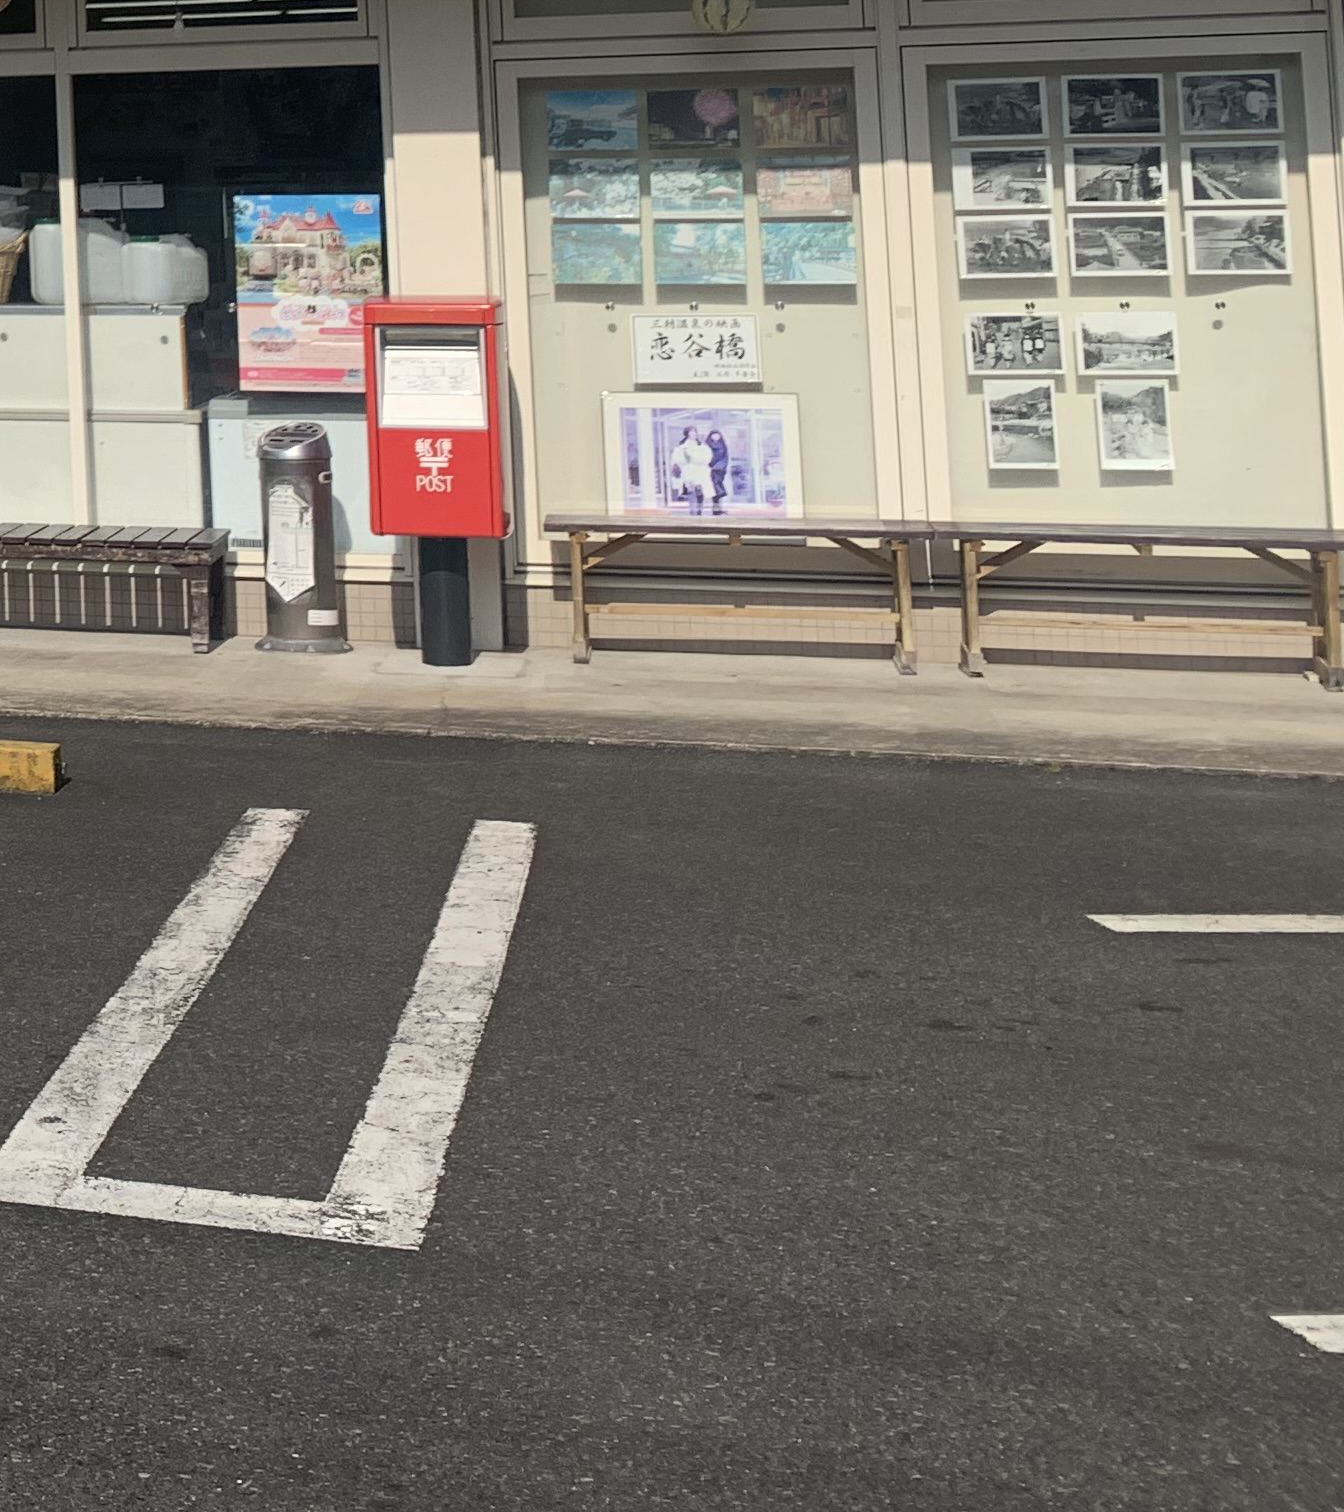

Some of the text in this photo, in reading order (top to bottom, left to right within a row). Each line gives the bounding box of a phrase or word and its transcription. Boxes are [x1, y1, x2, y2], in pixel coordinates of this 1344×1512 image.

[650, 332, 746, 361] 恋谷橋
[414, 438, 454, 458] 郵便
[415, 475, 454, 493] POST
